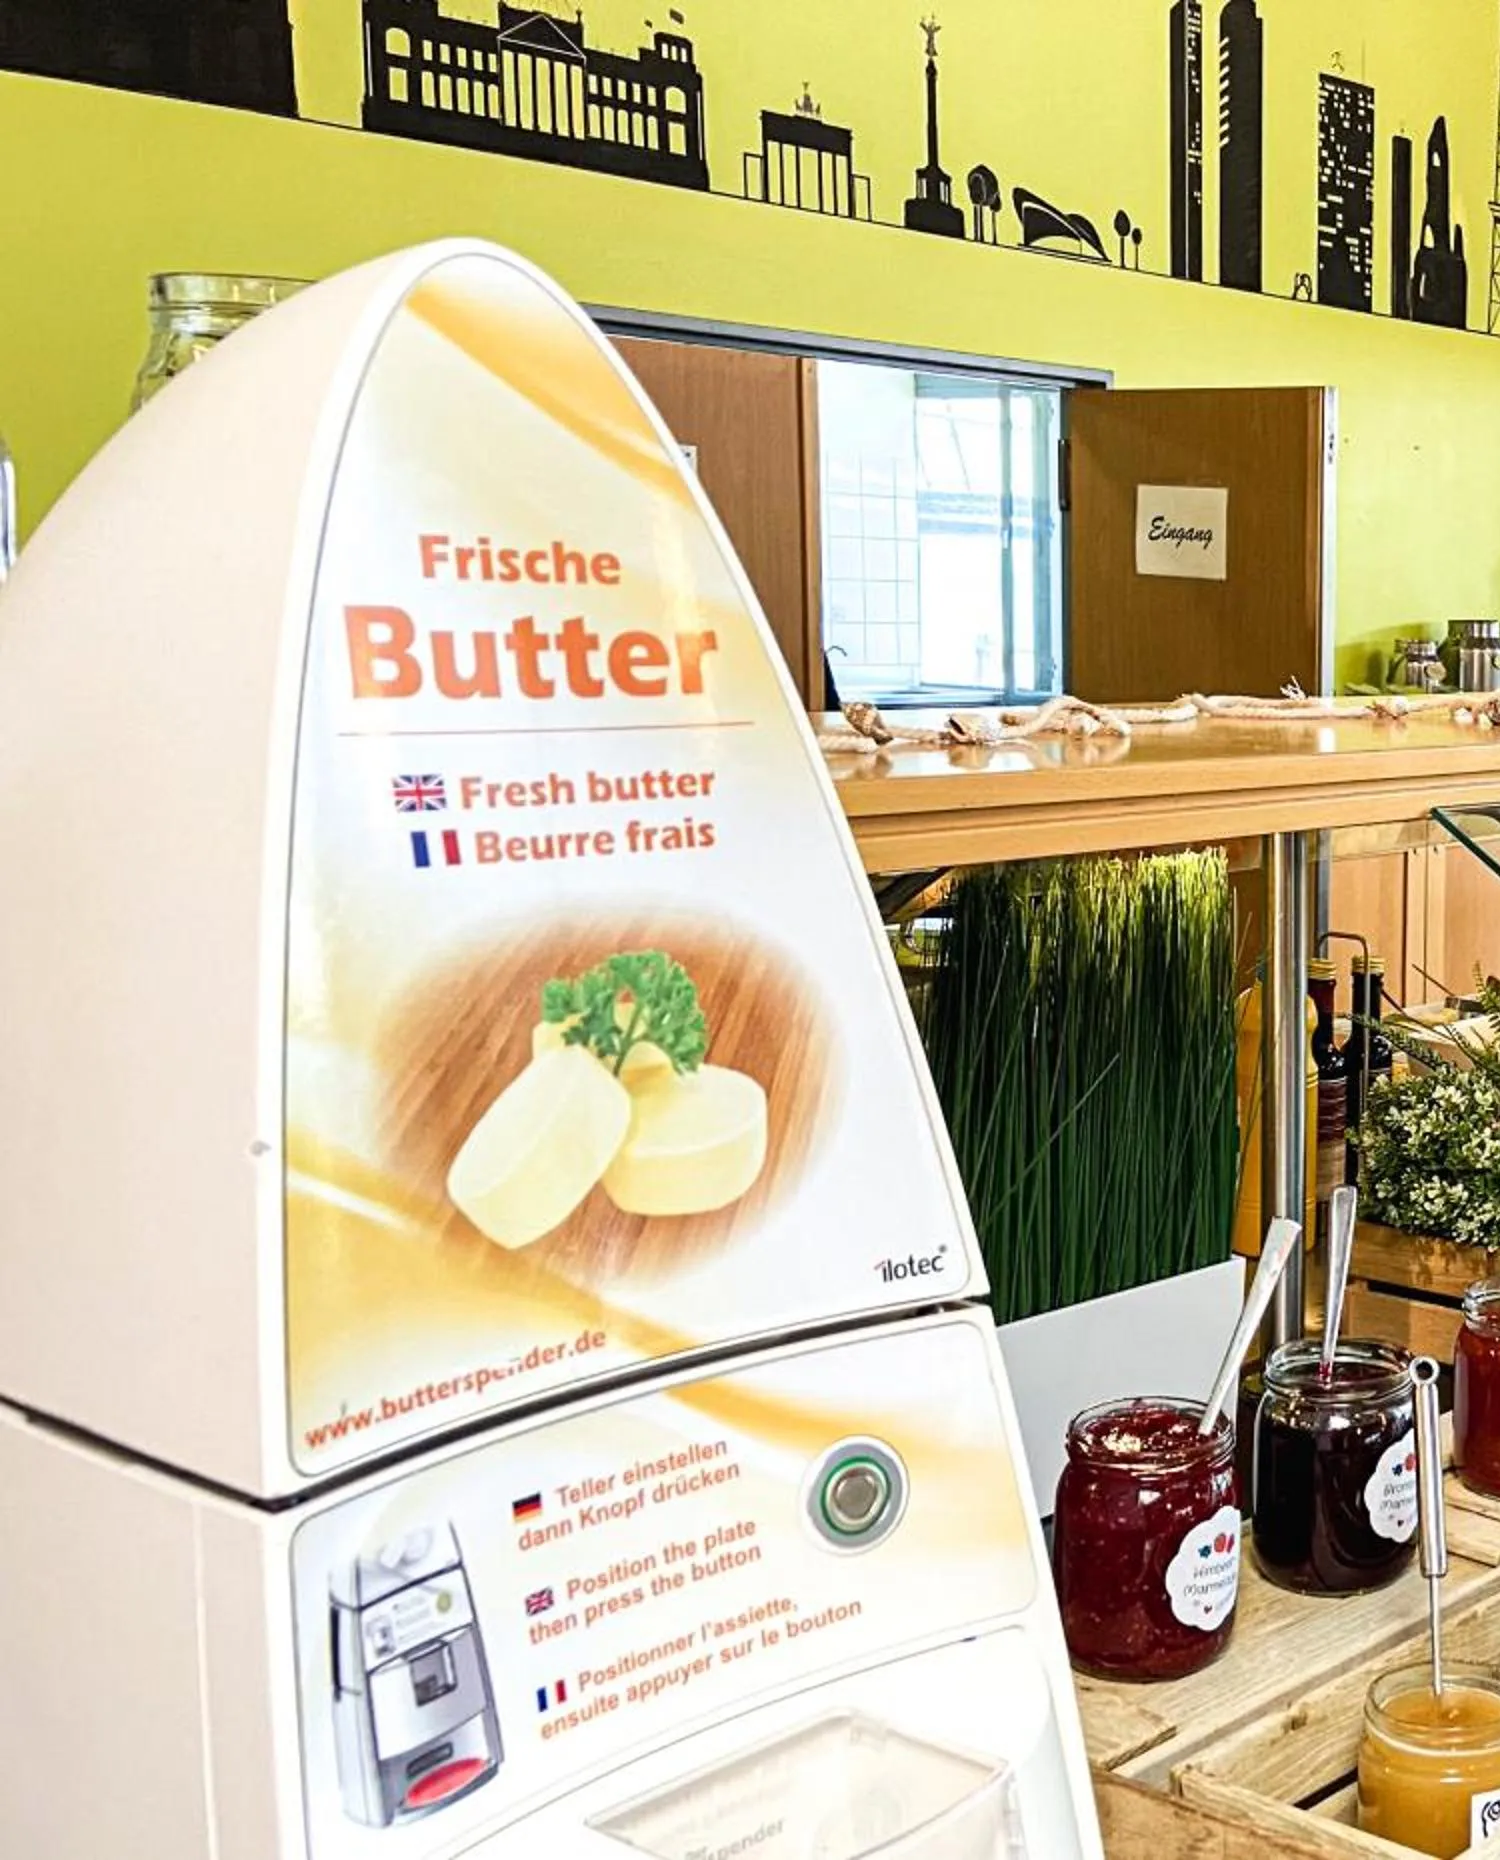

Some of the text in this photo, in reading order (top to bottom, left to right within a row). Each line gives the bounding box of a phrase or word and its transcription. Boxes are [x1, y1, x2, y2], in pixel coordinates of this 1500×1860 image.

[418, 535, 621, 586] Frische
[1148, 515, 1213, 550] Eingang
[343, 604, 719, 702] Butter
[460, 769, 716, 809] Fresh butter
[474, 819, 716, 865] Beurre frais
[304, 1329, 607, 1449] www.butterspder.de
[518, 1463, 740, 1551] dann Knopf drücken
[556, 1440, 728, 1507] Teller einstellen
[529, 1545, 762, 1645] then press the button
[566, 1521, 756, 1599] Position the plate
[541, 1601, 862, 1740] ensuite appuyer sur le bouton
[578, 1632, 695, 1692] Positionner
